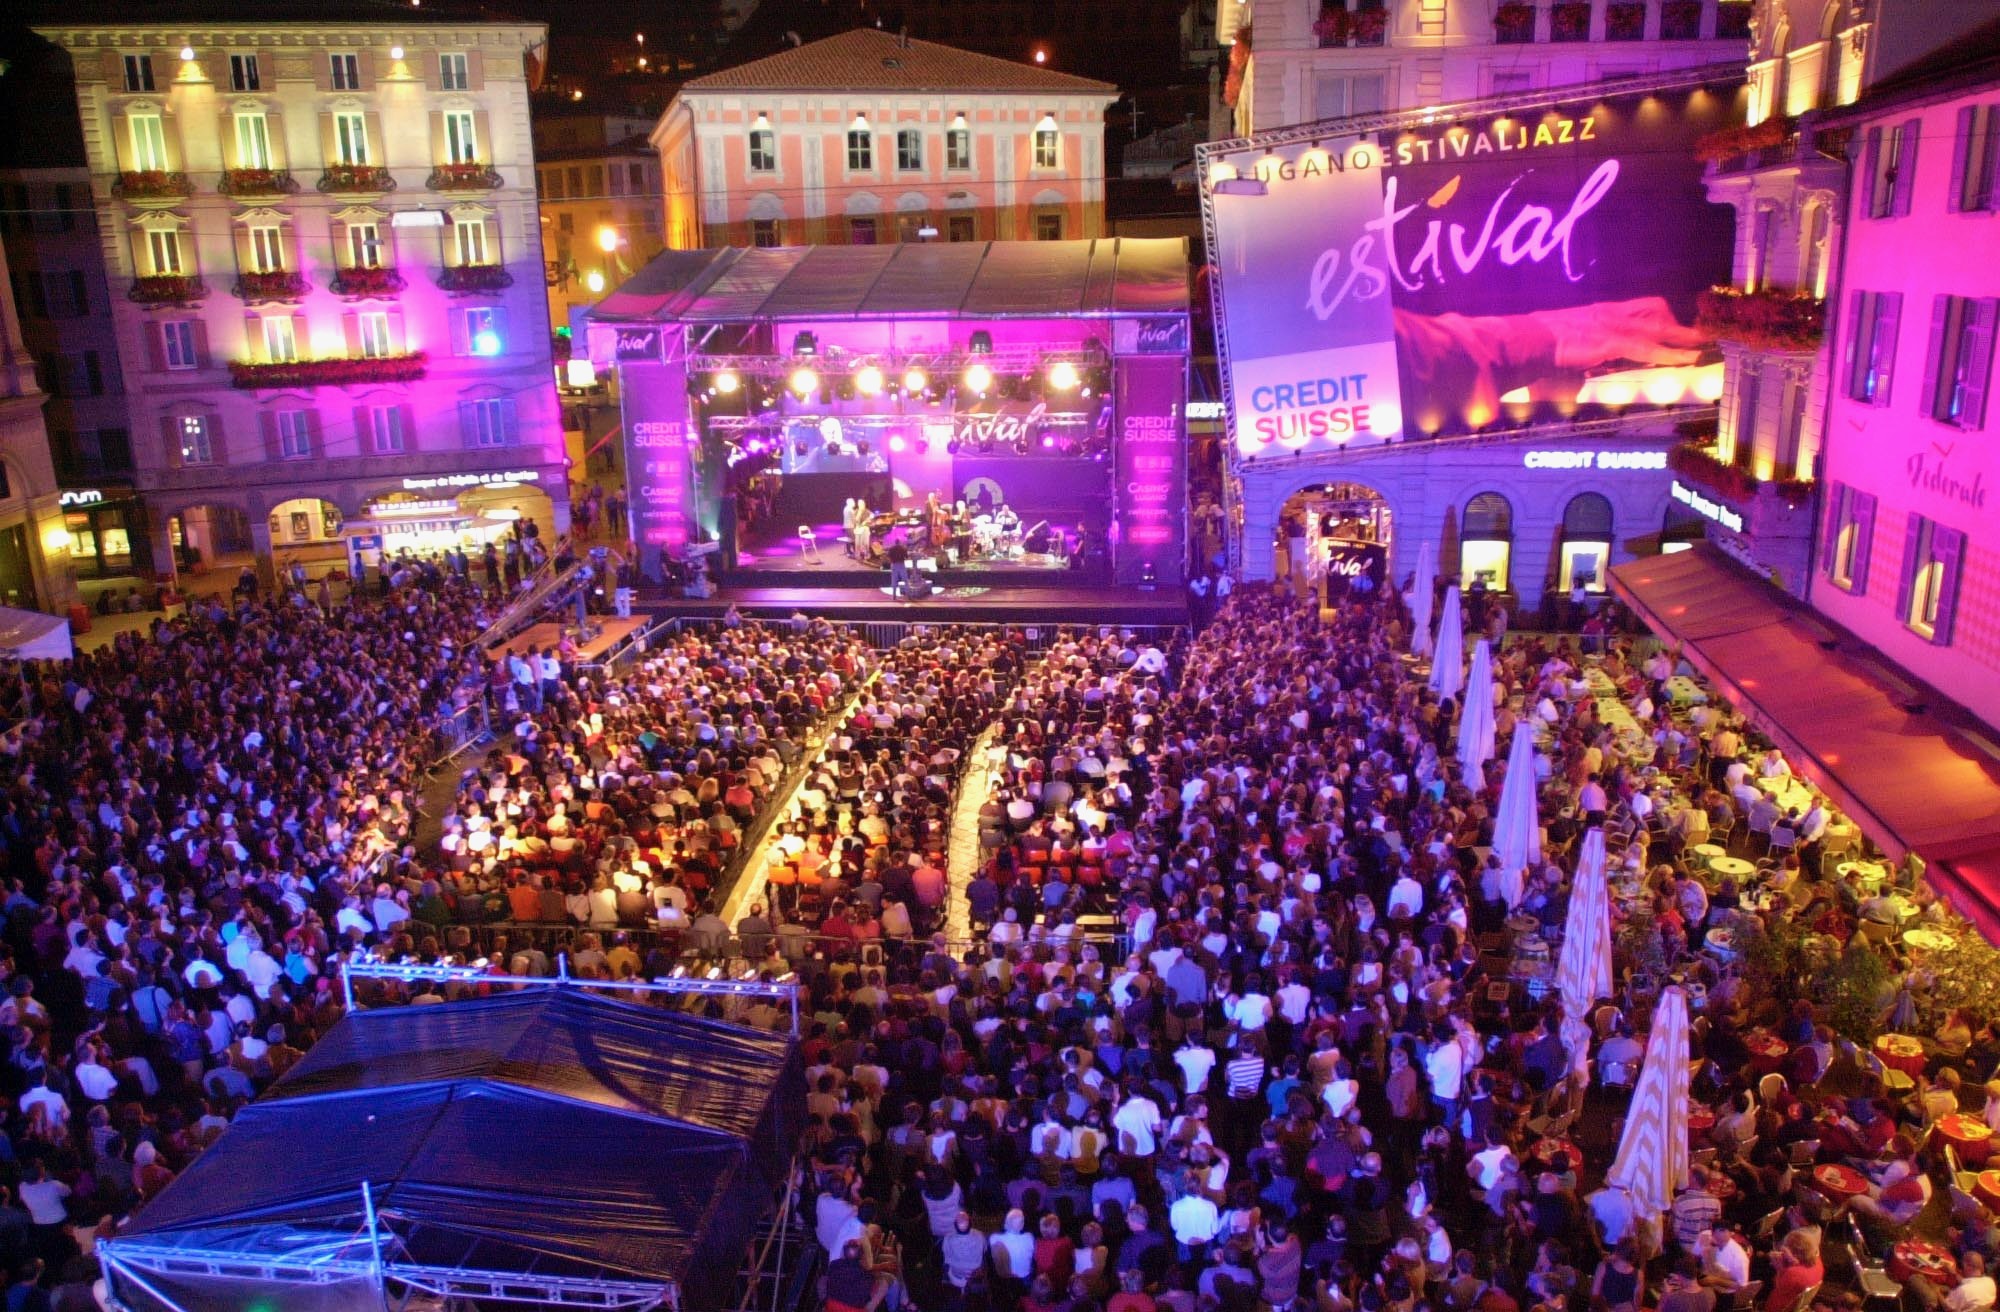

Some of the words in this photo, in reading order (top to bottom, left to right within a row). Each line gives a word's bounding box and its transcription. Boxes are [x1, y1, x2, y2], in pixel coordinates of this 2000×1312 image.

[1306, 158, 1620, 321] estival
[1251, 373, 1368, 413] CREDIT
[633, 422, 681, 434] CREDIT
[1124, 415, 1176, 429] CREDIT
[1255, 404, 1371, 443] SUISSE
[634, 434, 682, 447] SUISSE
[1124, 429, 1176, 442] SUISSE
[1524, 451, 1595, 468] CREDIT
[1597, 451, 1667, 469] SUISSE
